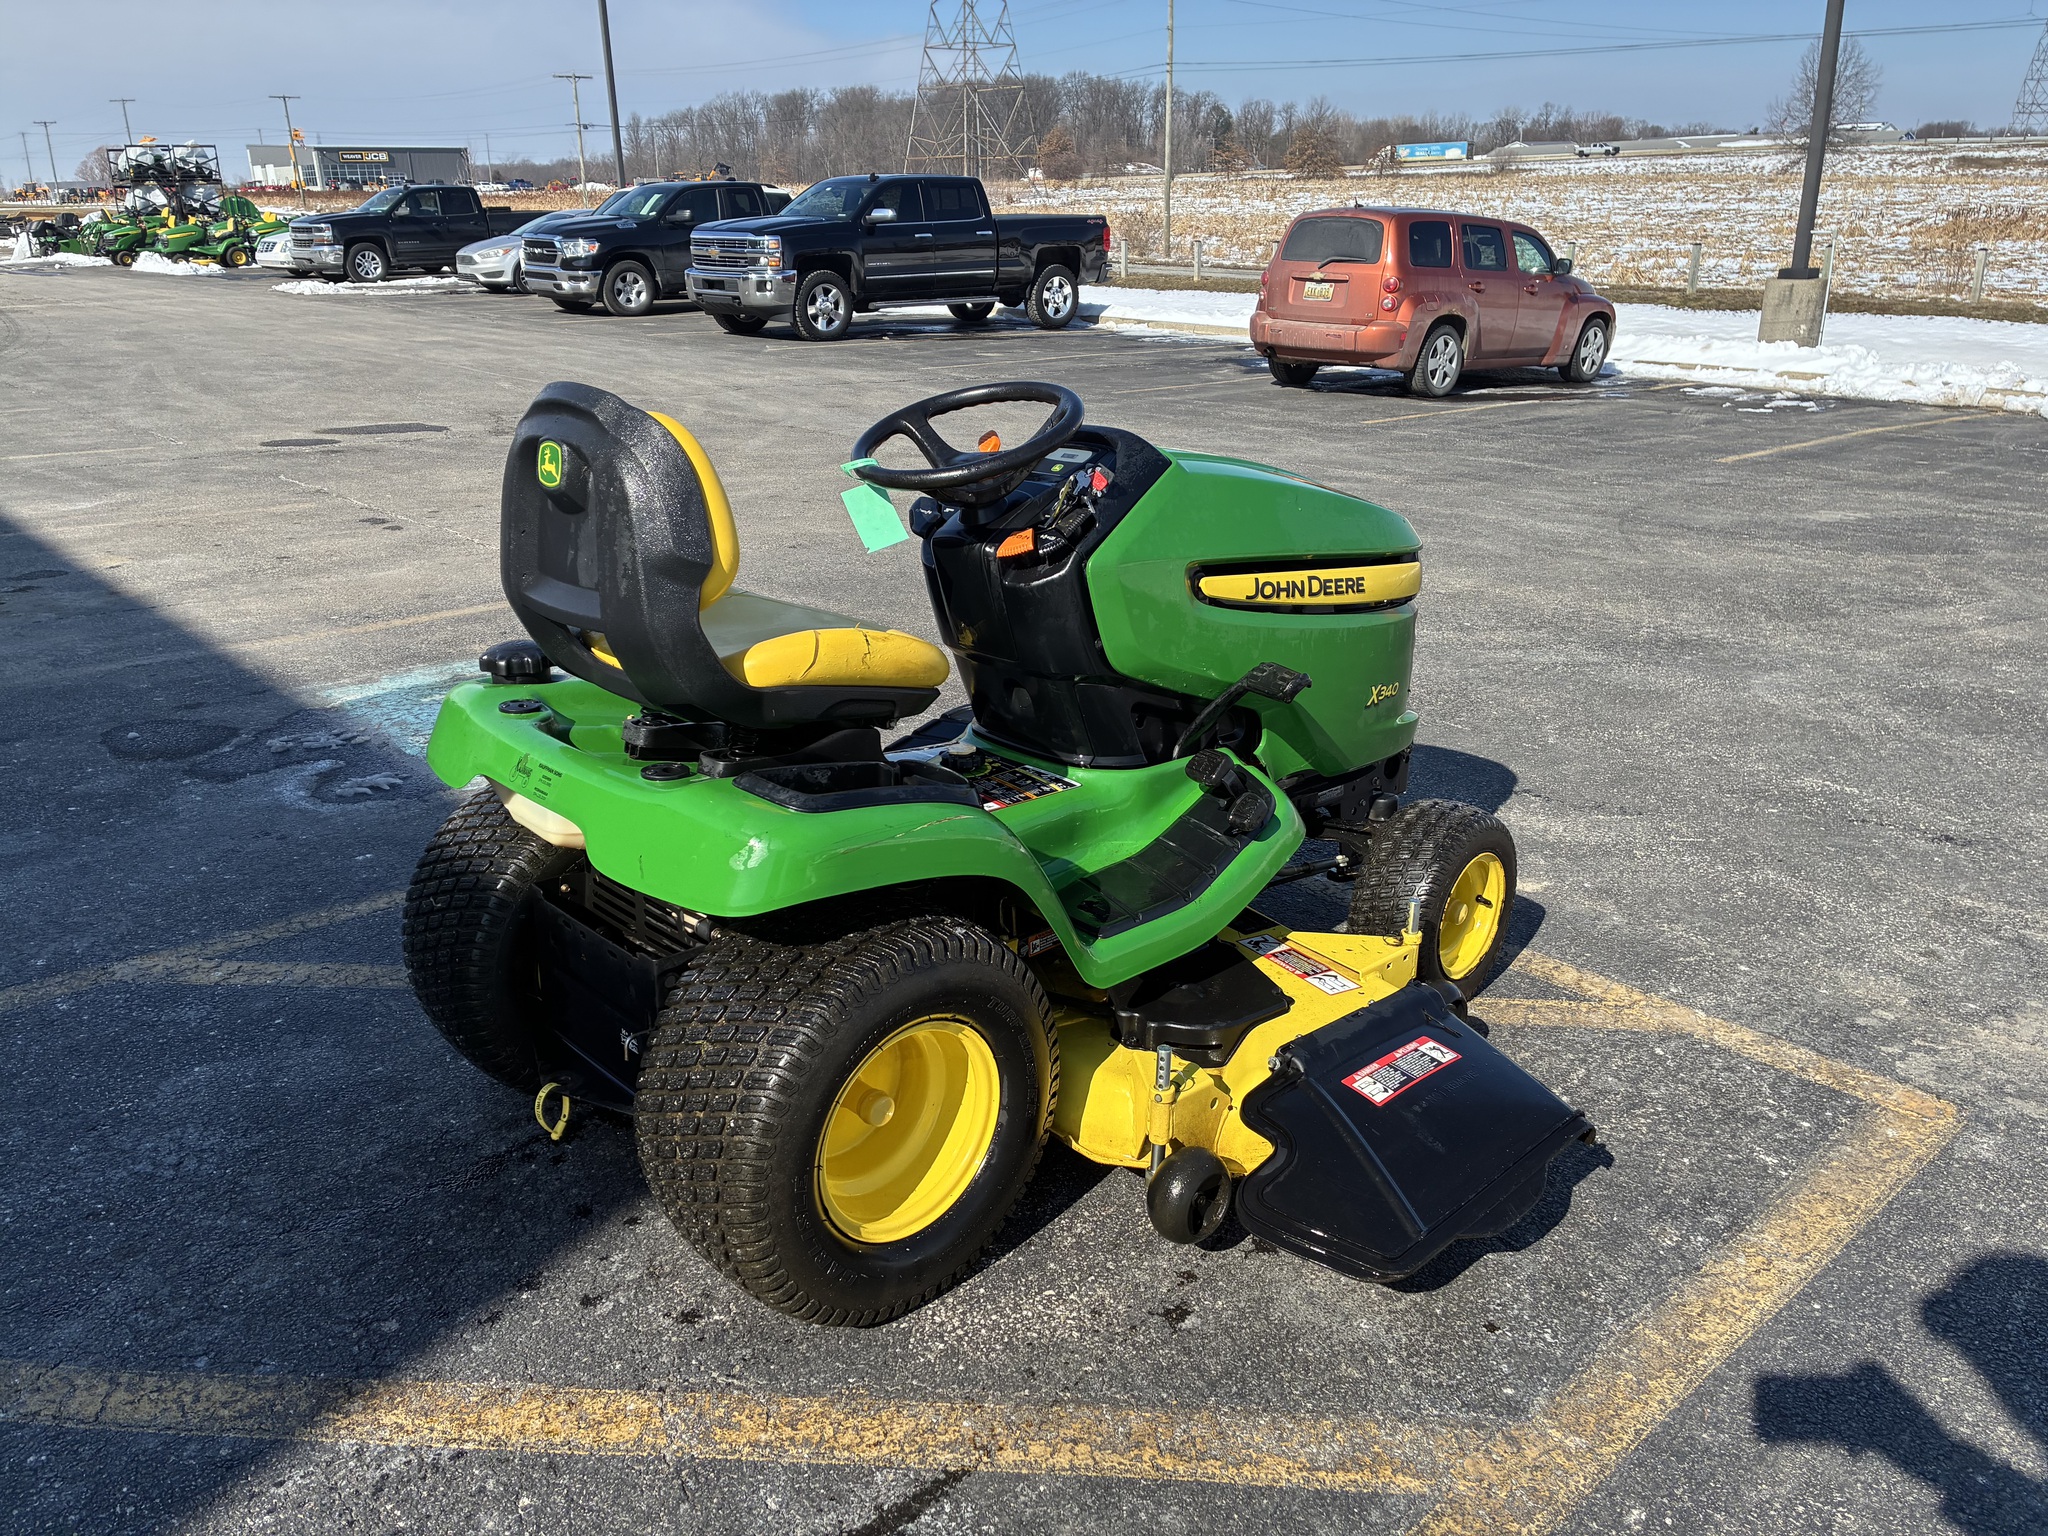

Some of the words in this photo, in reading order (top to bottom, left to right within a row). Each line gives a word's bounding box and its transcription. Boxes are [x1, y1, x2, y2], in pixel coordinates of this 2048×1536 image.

[365, 152, 387, 160] JCB
[1246, 577, 1305, 599] JOHN
[1307, 575, 1365, 597] DEERE
[1366, 681, 1399, 706] X340
[987, 996, 1024, 1028] TURF
